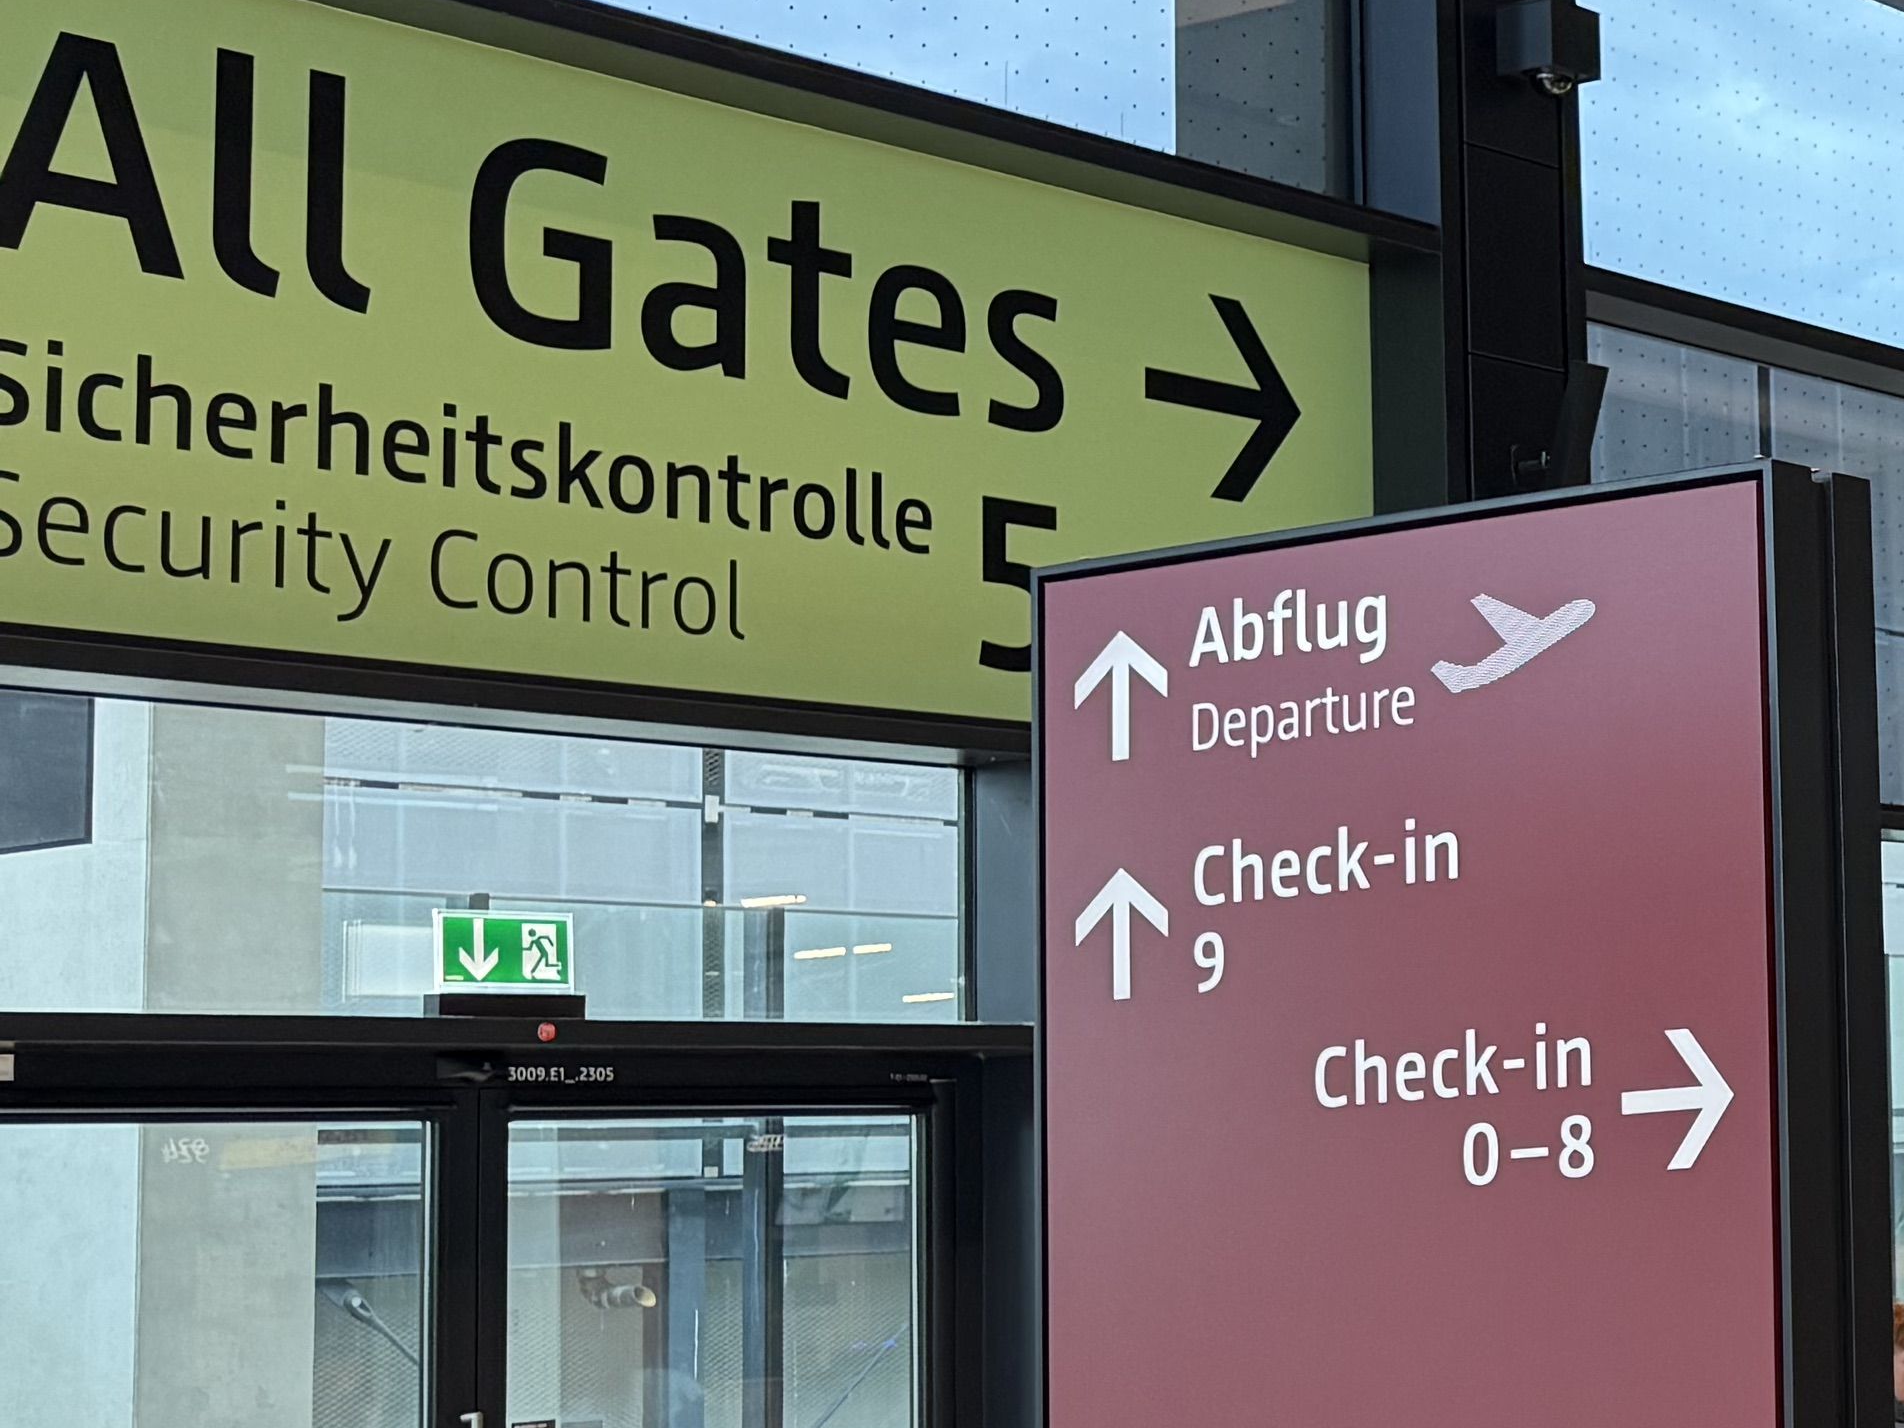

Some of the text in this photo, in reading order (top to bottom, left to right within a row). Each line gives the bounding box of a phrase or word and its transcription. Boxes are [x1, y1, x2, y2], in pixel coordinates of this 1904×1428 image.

[0, 32, 1065, 433] All Gates
[430, 529, 745, 641] Control
[979, 495, 1057, 673] 5
[1188, 588, 1387, 668] Abflug
[1192, 686, 1415, 759] Departure
[1194, 818, 1459, 906] Check-in
[1193, 931, 1225, 994] 9
[1314, 1022, 1592, 1108] Check-in
